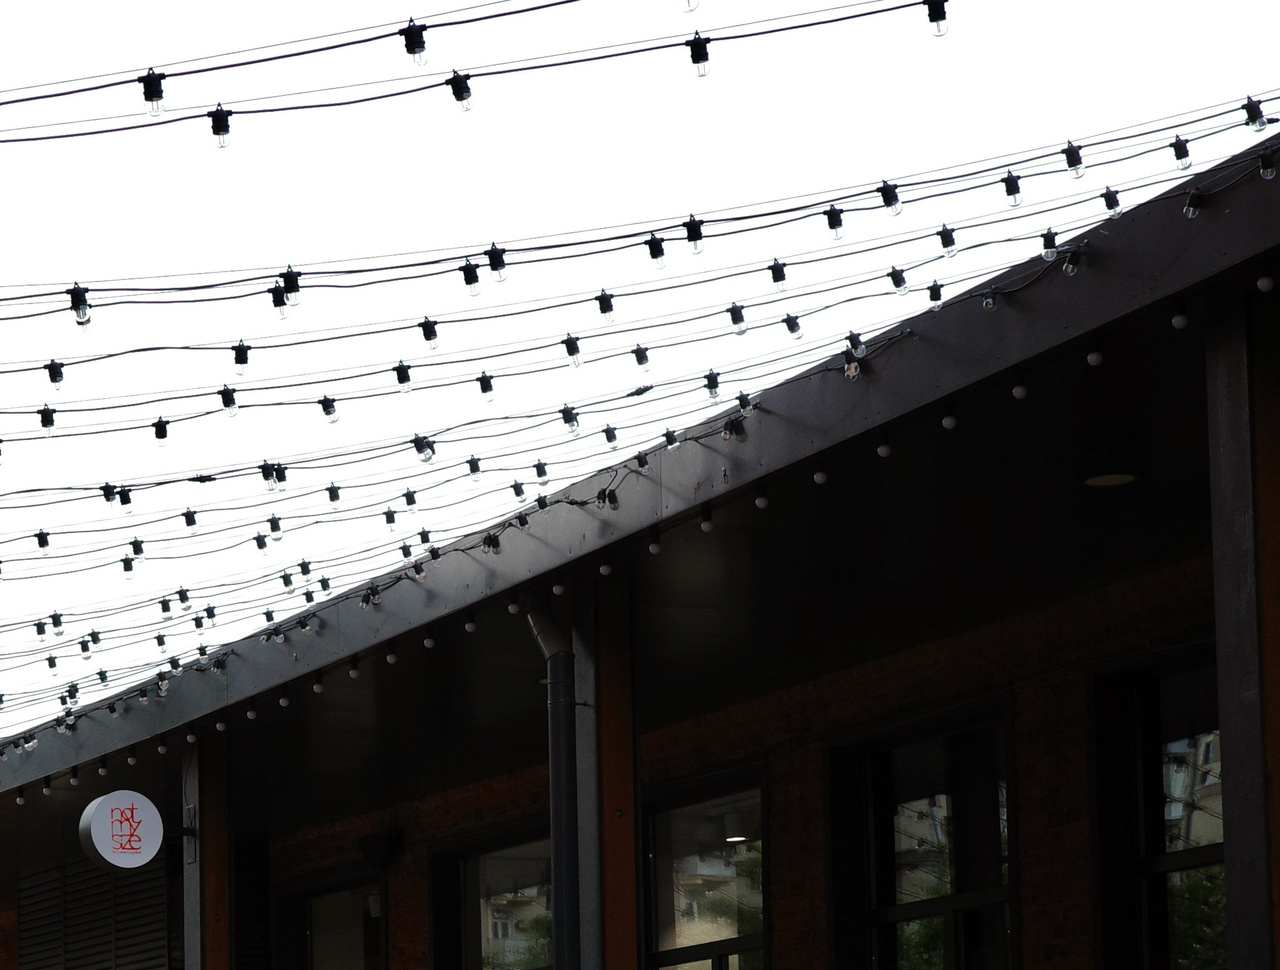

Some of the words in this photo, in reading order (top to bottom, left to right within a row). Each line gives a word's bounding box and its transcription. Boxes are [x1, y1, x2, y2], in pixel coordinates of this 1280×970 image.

[110, 802, 139, 822] not
[111, 819, 142, 836] my
[111, 834, 142, 850] size
